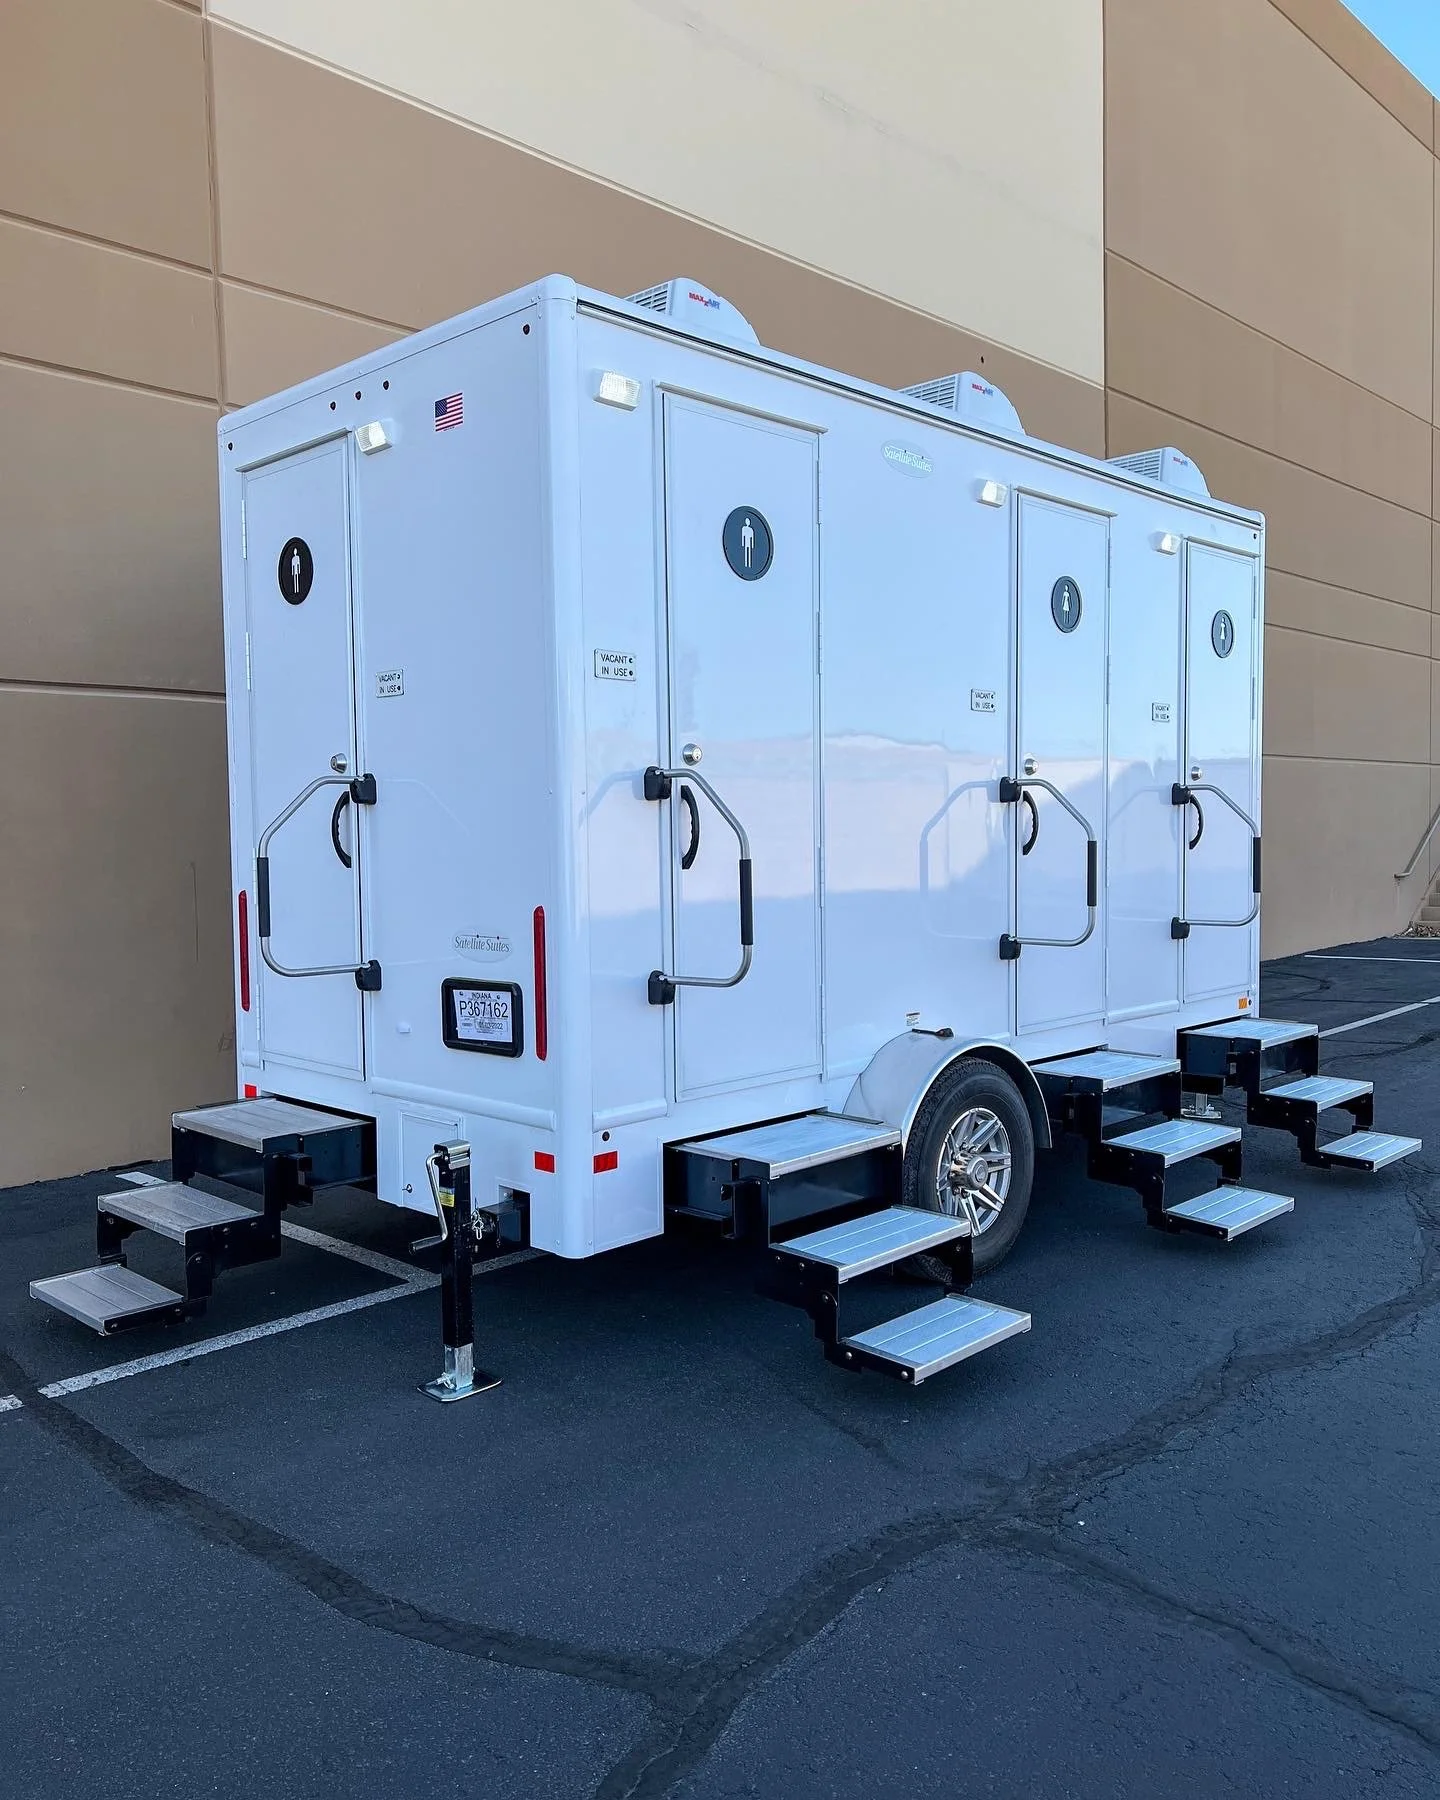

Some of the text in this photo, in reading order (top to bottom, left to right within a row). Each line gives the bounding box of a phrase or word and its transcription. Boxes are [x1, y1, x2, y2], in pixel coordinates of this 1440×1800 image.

[884, 447, 933, 473] Satellite Suites
[600, 653, 628, 664] VACANT
[601, 666, 628, 677] IN USE
[454, 935, 510, 953] Satellite Suites
[471, 992, 492, 1000] INDIANA
[459, 1000, 509, 1018] P367162
